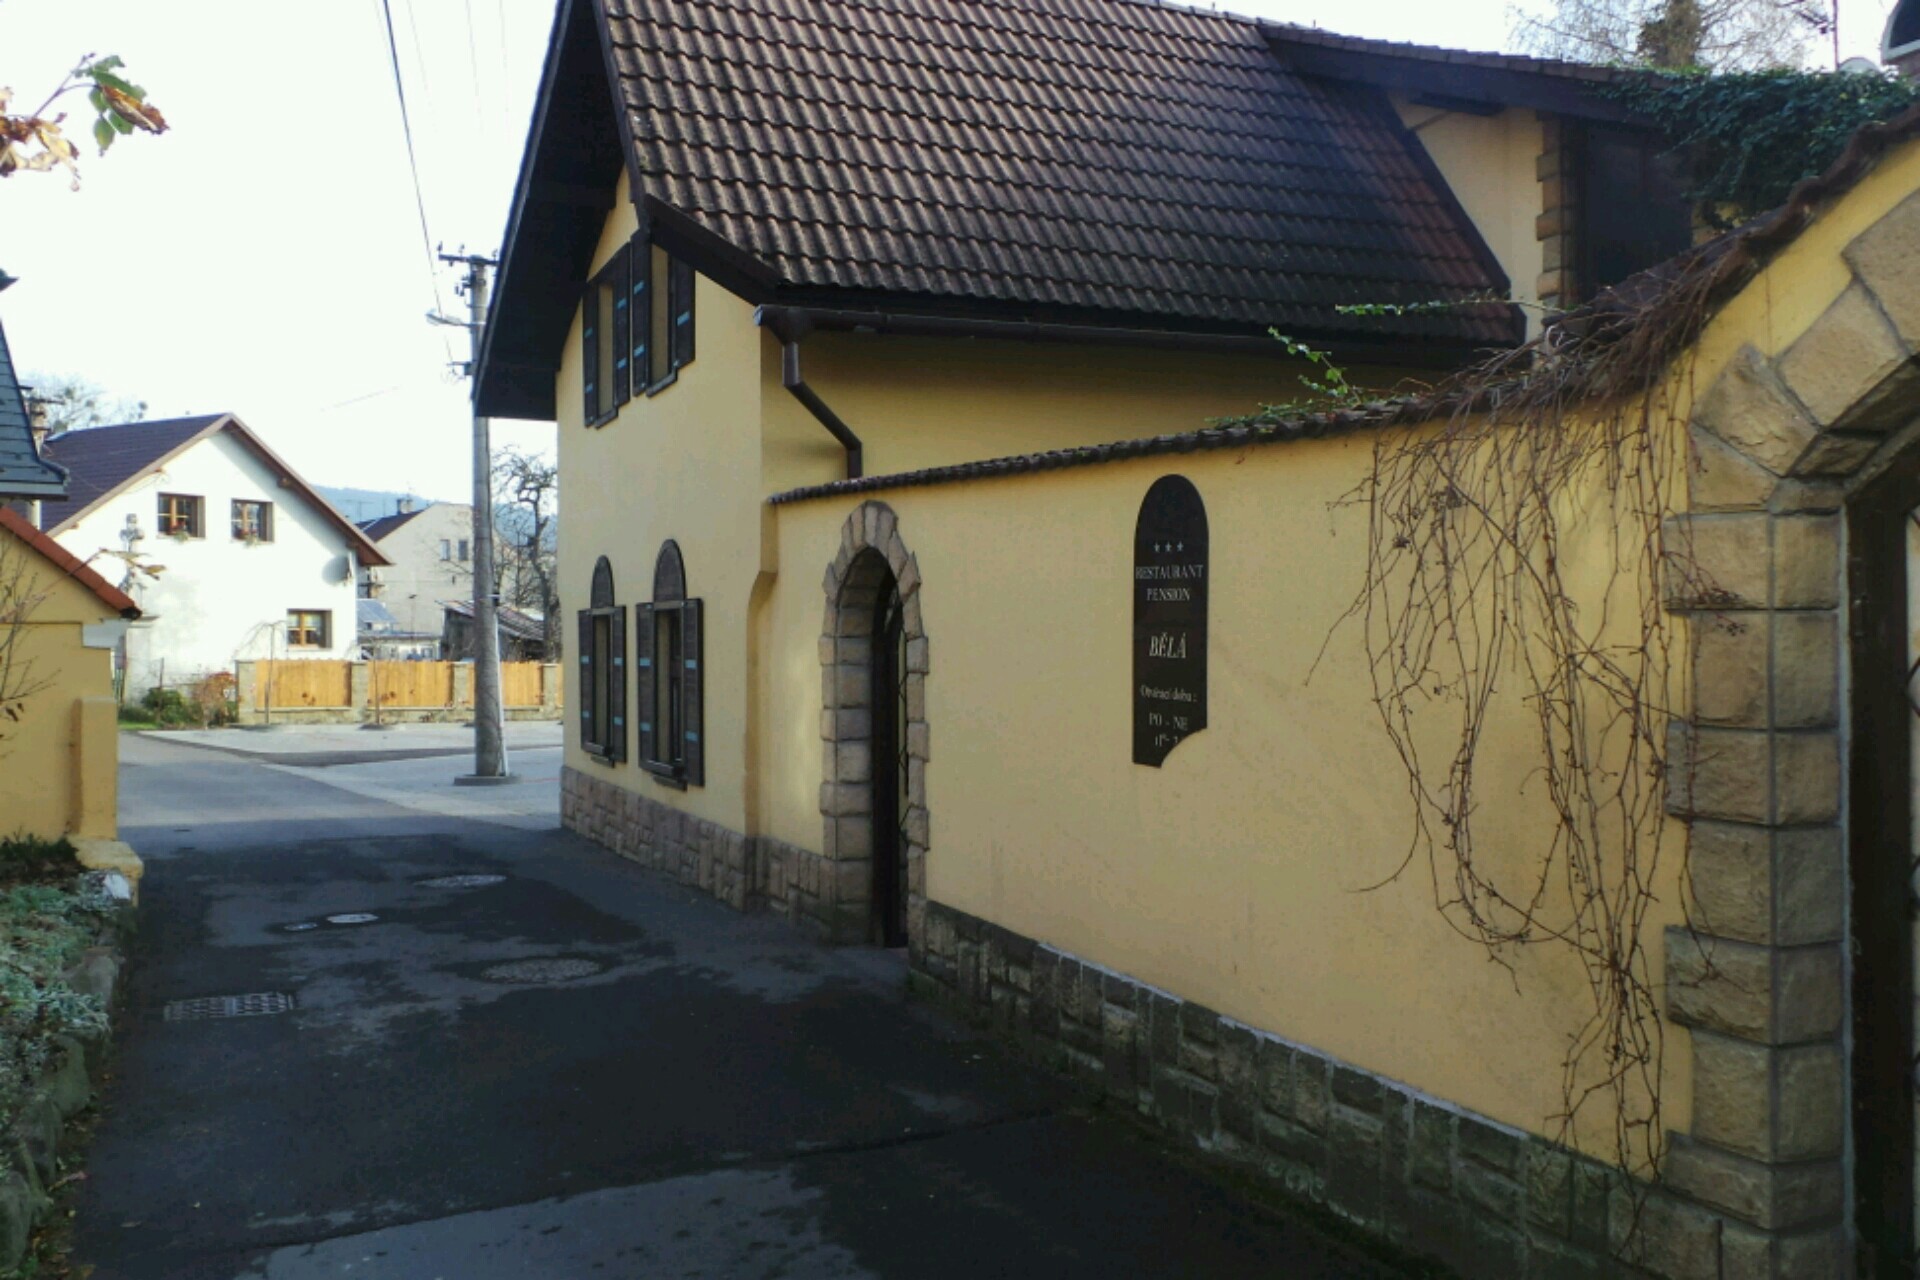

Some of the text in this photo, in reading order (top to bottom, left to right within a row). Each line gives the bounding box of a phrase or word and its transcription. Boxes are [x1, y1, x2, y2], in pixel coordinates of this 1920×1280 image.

[1135, 564, 1203, 579] RESTAURANT
[1147, 587, 1190, 601] PENSION
[1149, 632, 1186, 659] BĚLÁ
